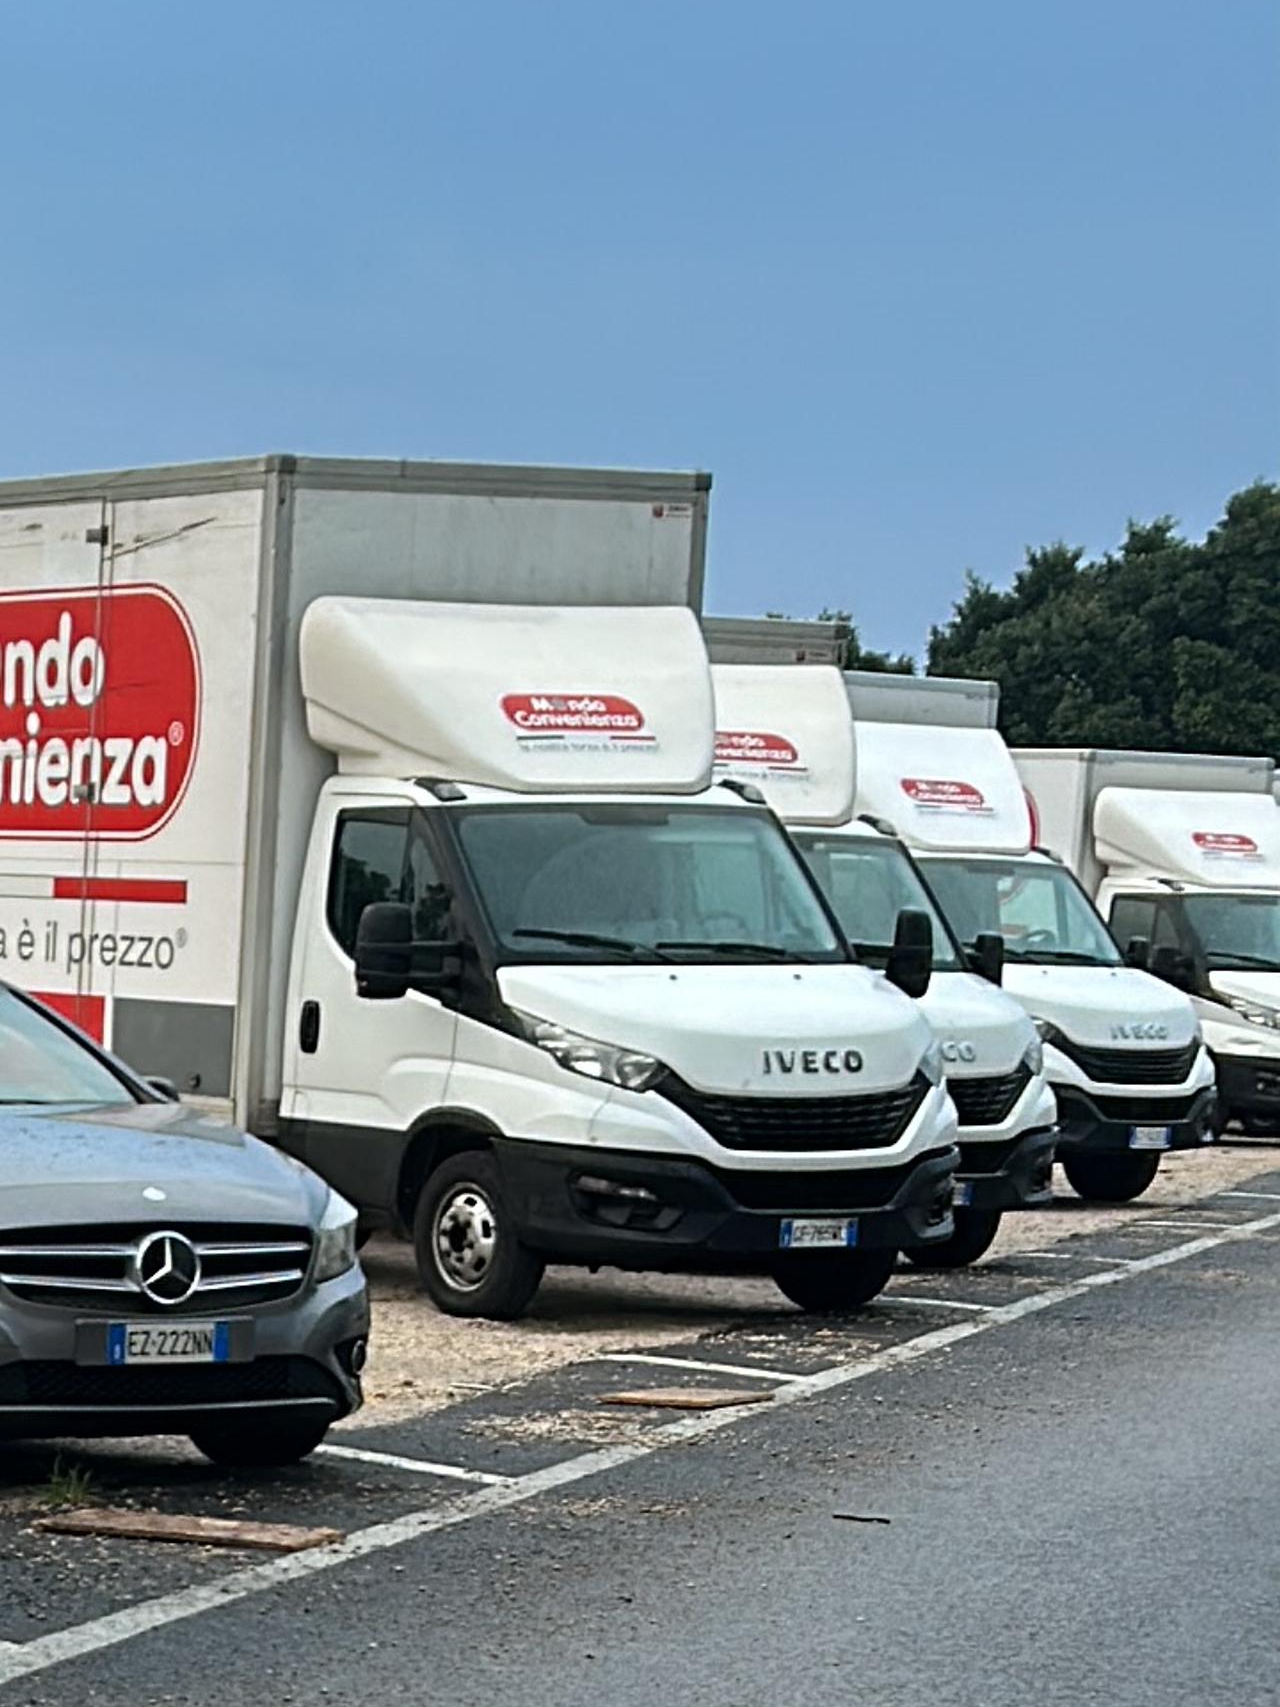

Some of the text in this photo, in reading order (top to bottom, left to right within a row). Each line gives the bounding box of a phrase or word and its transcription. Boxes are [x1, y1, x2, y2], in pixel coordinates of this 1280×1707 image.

[17, 918, 36, 960] è
[44, 920, 58, 962] il
[762, 1049, 864, 1075] IVECO
